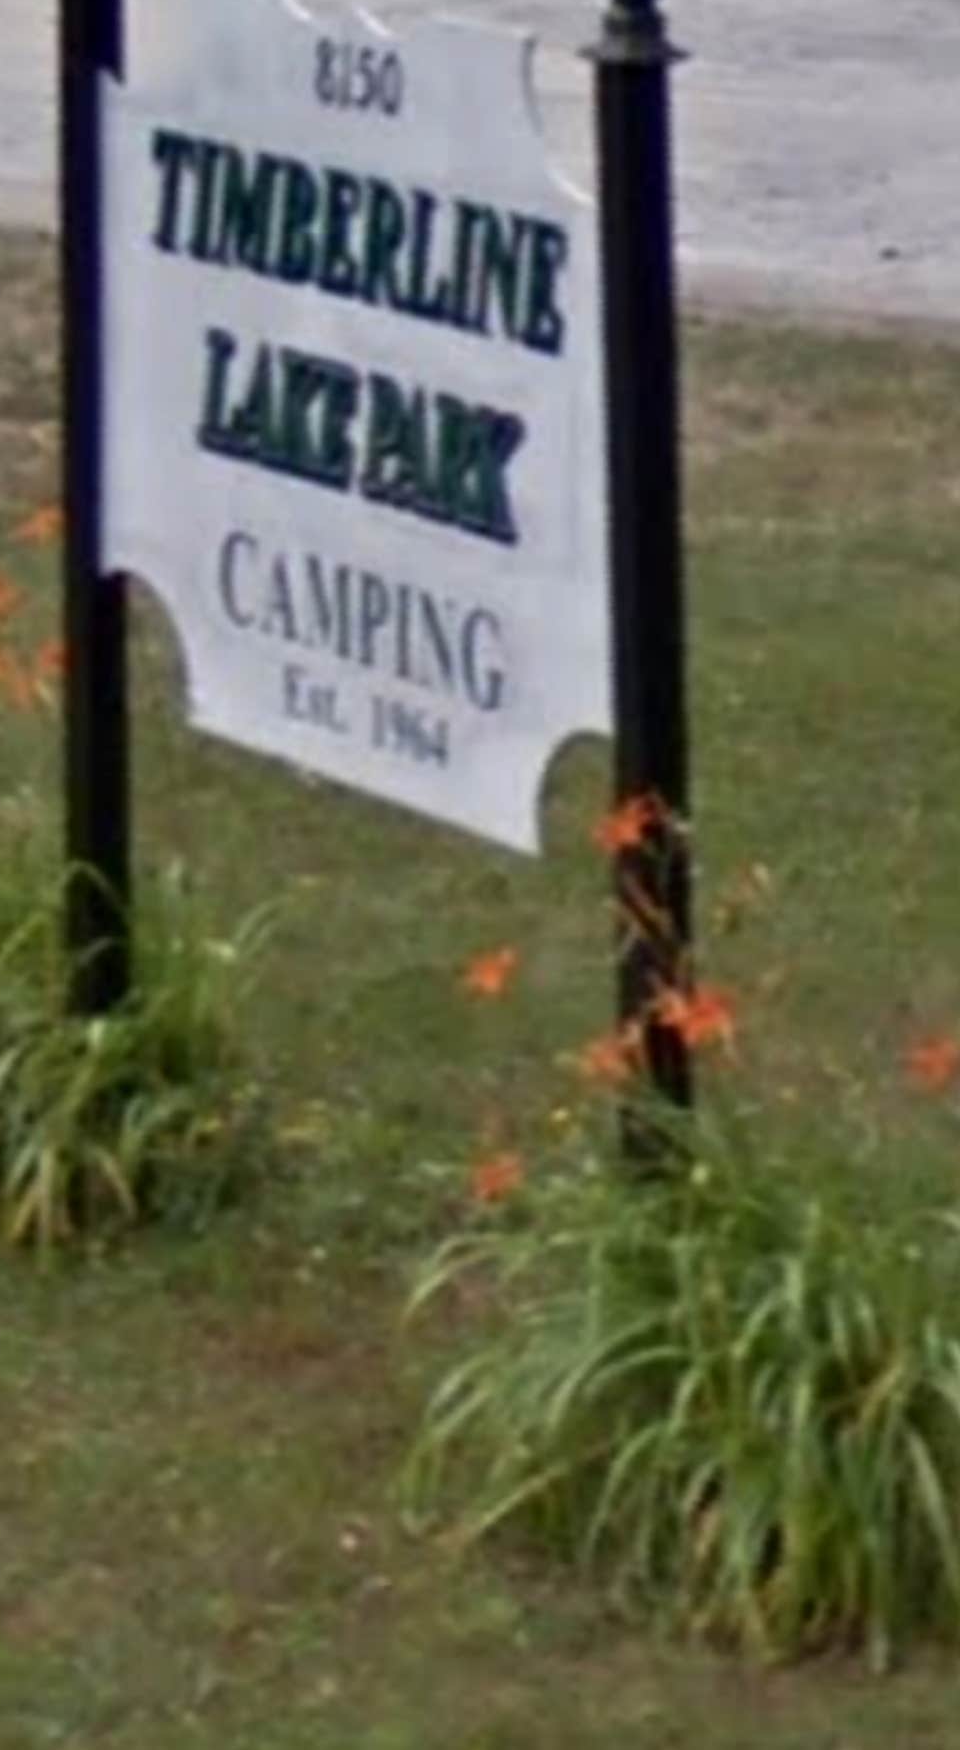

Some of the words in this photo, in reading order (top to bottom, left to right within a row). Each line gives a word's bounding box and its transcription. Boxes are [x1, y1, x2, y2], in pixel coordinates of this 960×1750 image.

[313, 38, 404, 116] 8150
[152, 128, 568, 357] TIMBERLINE
[197, 327, 361, 494] LAKE
[359, 372, 526, 547] PARK
[219, 531, 504, 711] CAMPING
[282, 663, 349, 734] Est.
[371, 695, 451, 769] 1964
